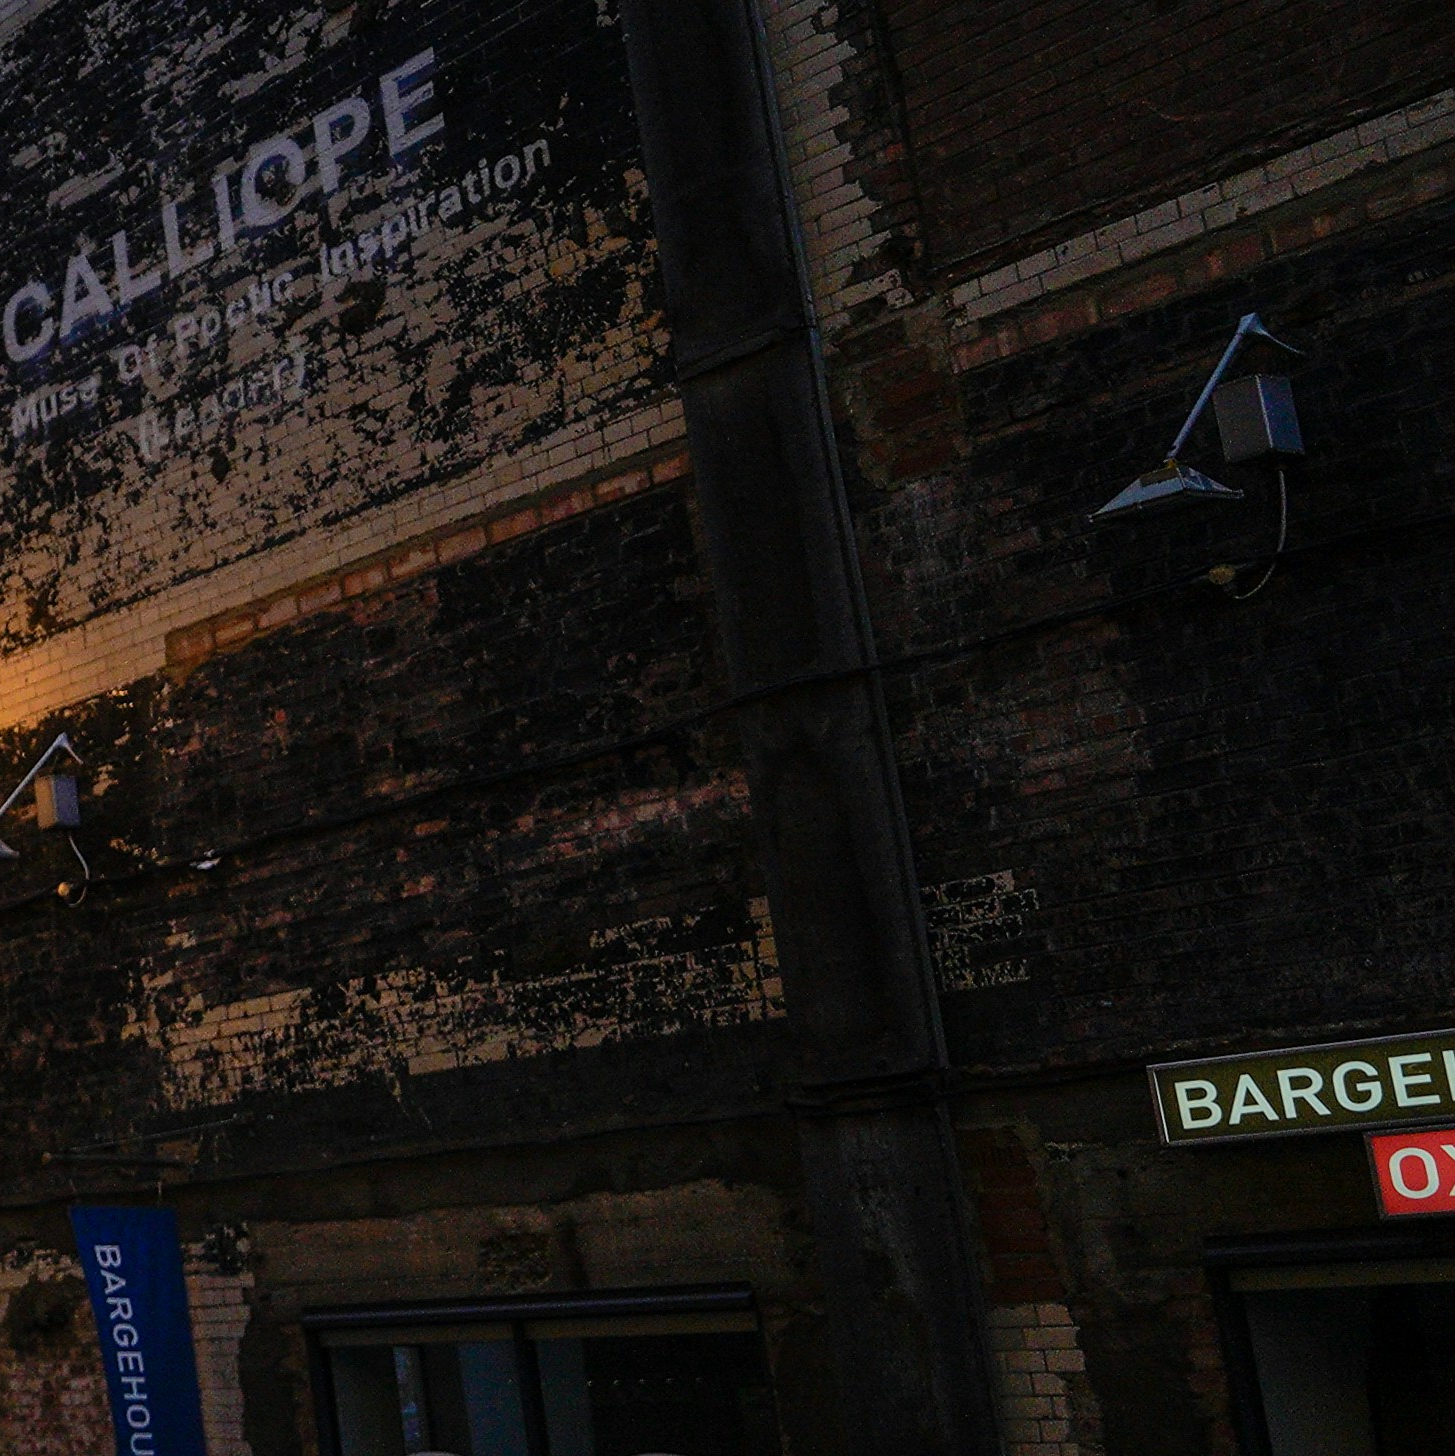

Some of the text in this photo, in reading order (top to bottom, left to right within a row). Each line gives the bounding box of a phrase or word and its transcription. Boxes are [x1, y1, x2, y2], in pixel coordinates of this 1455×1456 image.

[3, 46, 446, 362] CALLIOPE
[11, 376, 100, 437] Muse
[321, 137, 552, 284] Inspiration
